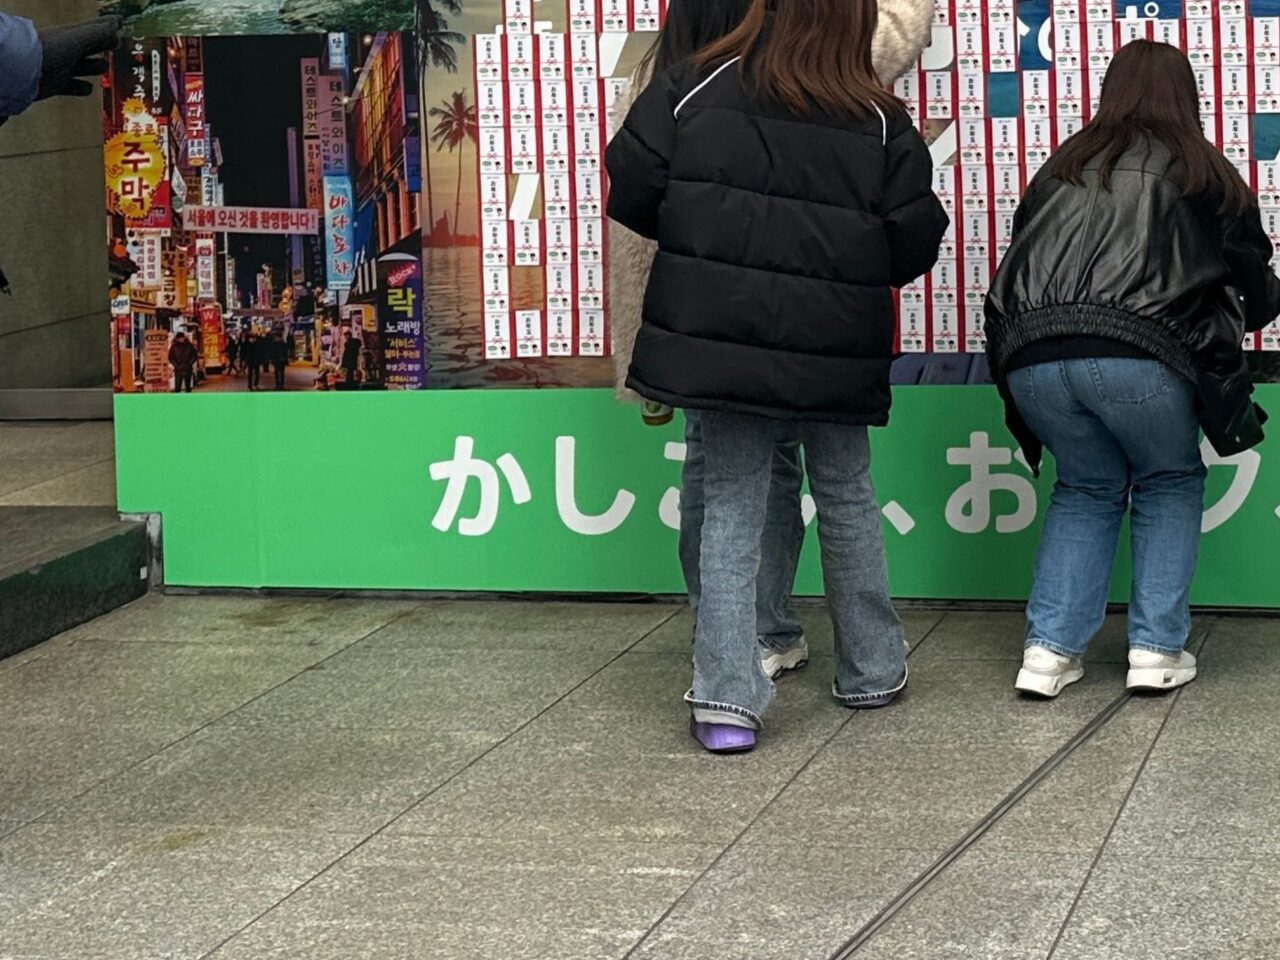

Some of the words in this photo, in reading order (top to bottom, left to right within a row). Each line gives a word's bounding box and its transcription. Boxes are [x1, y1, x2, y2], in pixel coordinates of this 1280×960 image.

[329, 81, 345, 170] 테스트와이즈
[120, 142, 150, 210] 주막
[328, 195, 350, 276] 바다포차
[384, 321, 421, 335] 노래방
[387, 288, 417, 319] 락
